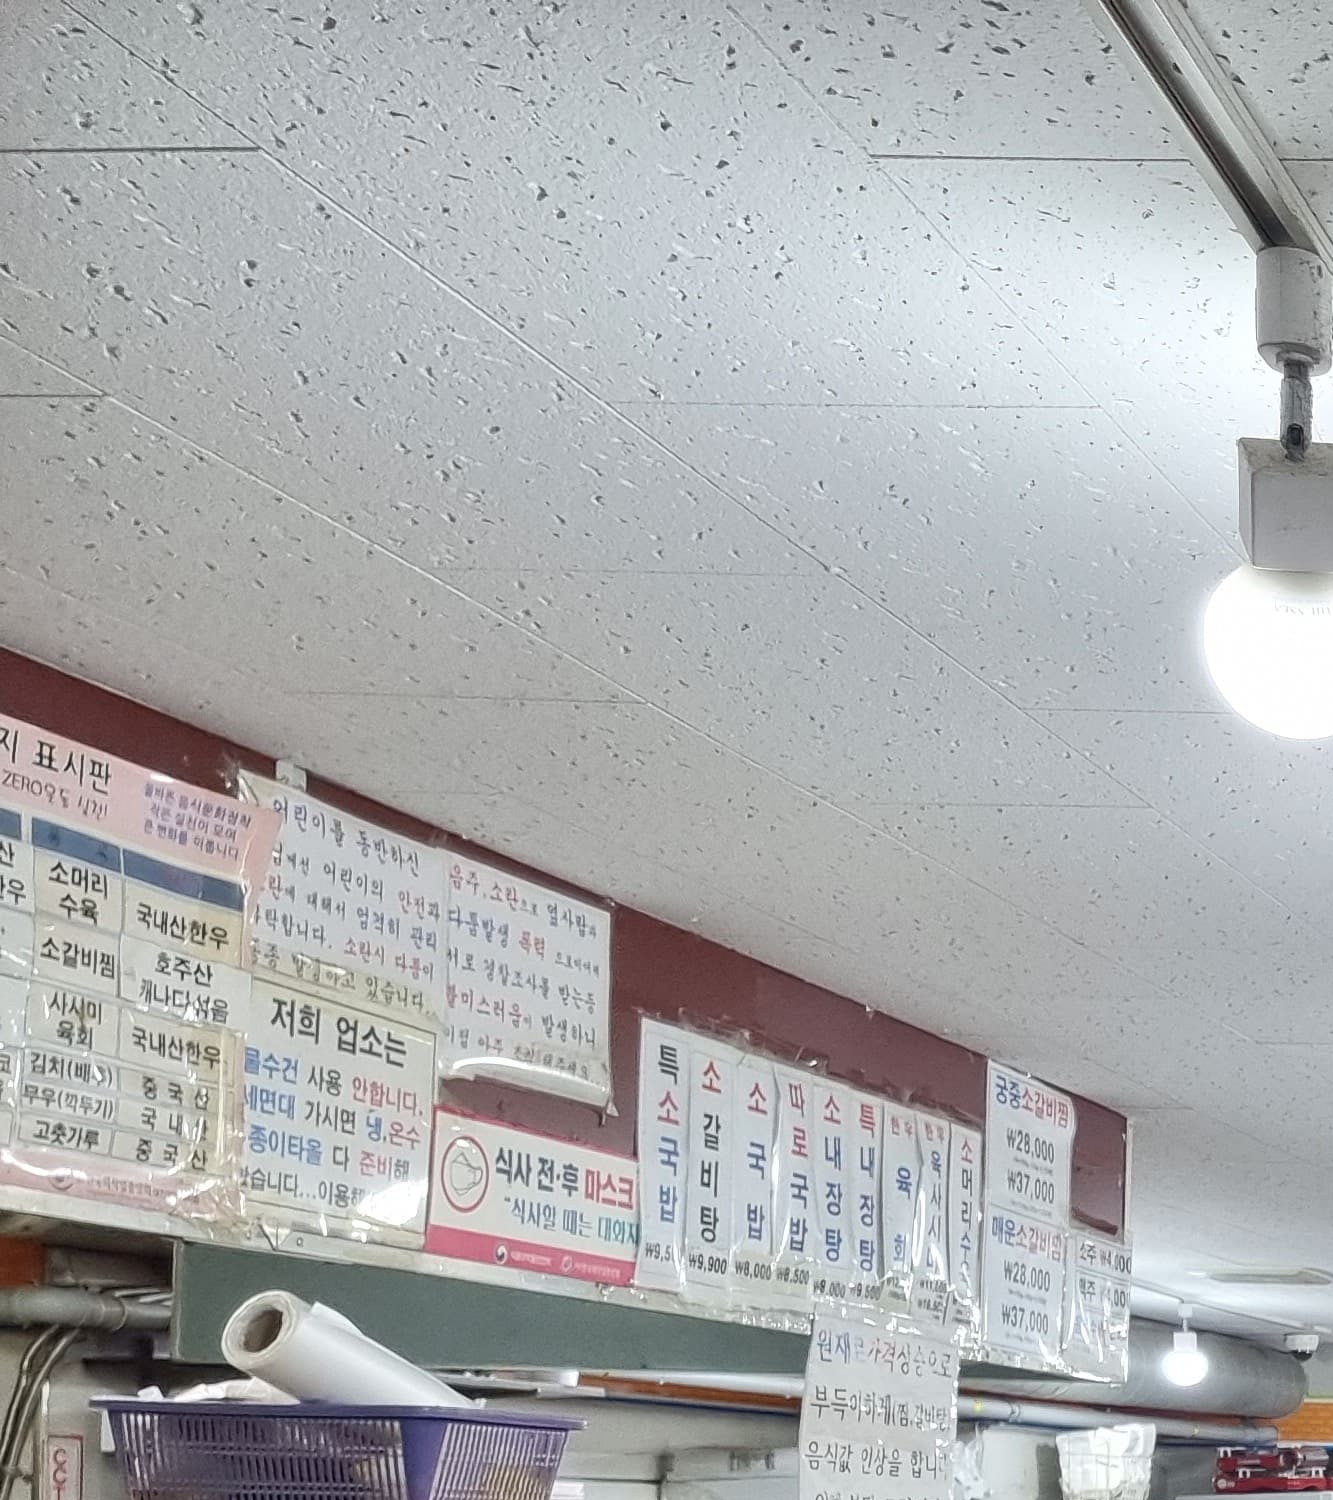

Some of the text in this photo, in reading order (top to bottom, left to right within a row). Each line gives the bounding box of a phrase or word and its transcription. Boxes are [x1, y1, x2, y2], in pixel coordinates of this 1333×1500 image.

[32, 739, 112, 796] 표시판
[273, 796, 345, 848] 어린이를
[357, 830, 419, 878] 동반하신
[48, 861, 108, 900] 소머리
[323, 861, 440, 923] 어린이의 안전과
[59, 893, 99, 926] 수육
[136, 902, 229, 950] 국내산한우
[40, 937, 115, 980] 소갈비찜
[410, 926, 437, 953] 관리
[155, 952, 213, 988] 호주산
[50, 990, 102, 1025] 사시미
[56, 1020, 93, 1050] 육회
[131, 1026, 221, 1069] 국내산한우
[270, 997, 407, 1069] 저희 업소는
[244, 1047, 424, 1118] 물수건 사용 안합니다.
[995, 1074, 1069, 1129] 궁중소갈비찜
[243, 1084, 295, 1121] 세면대
[304, 1101, 356, 1136] 가시면
[33, 1118, 100, 1150] 고춧가루
[248, 1124, 410, 1181] 종이타올 다 준비해
[1006, 1127, 1055, 1165] ₩28,000
[495, 1146, 532, 1188] 식사
[584, 1168, 634, 1211] 마스크
[1007, 1168, 1055, 1204] ₩37,000
[562, 1208, 593, 1239] 때는
[991, 1215, 1062, 1263] 매운소갈비찜
[1003, 1259, 1051, 1293] ₩28,000
[1001, 1303, 1049, 1336] ₩37,000
[804, 1441, 902, 1478] 음식값 인상을
